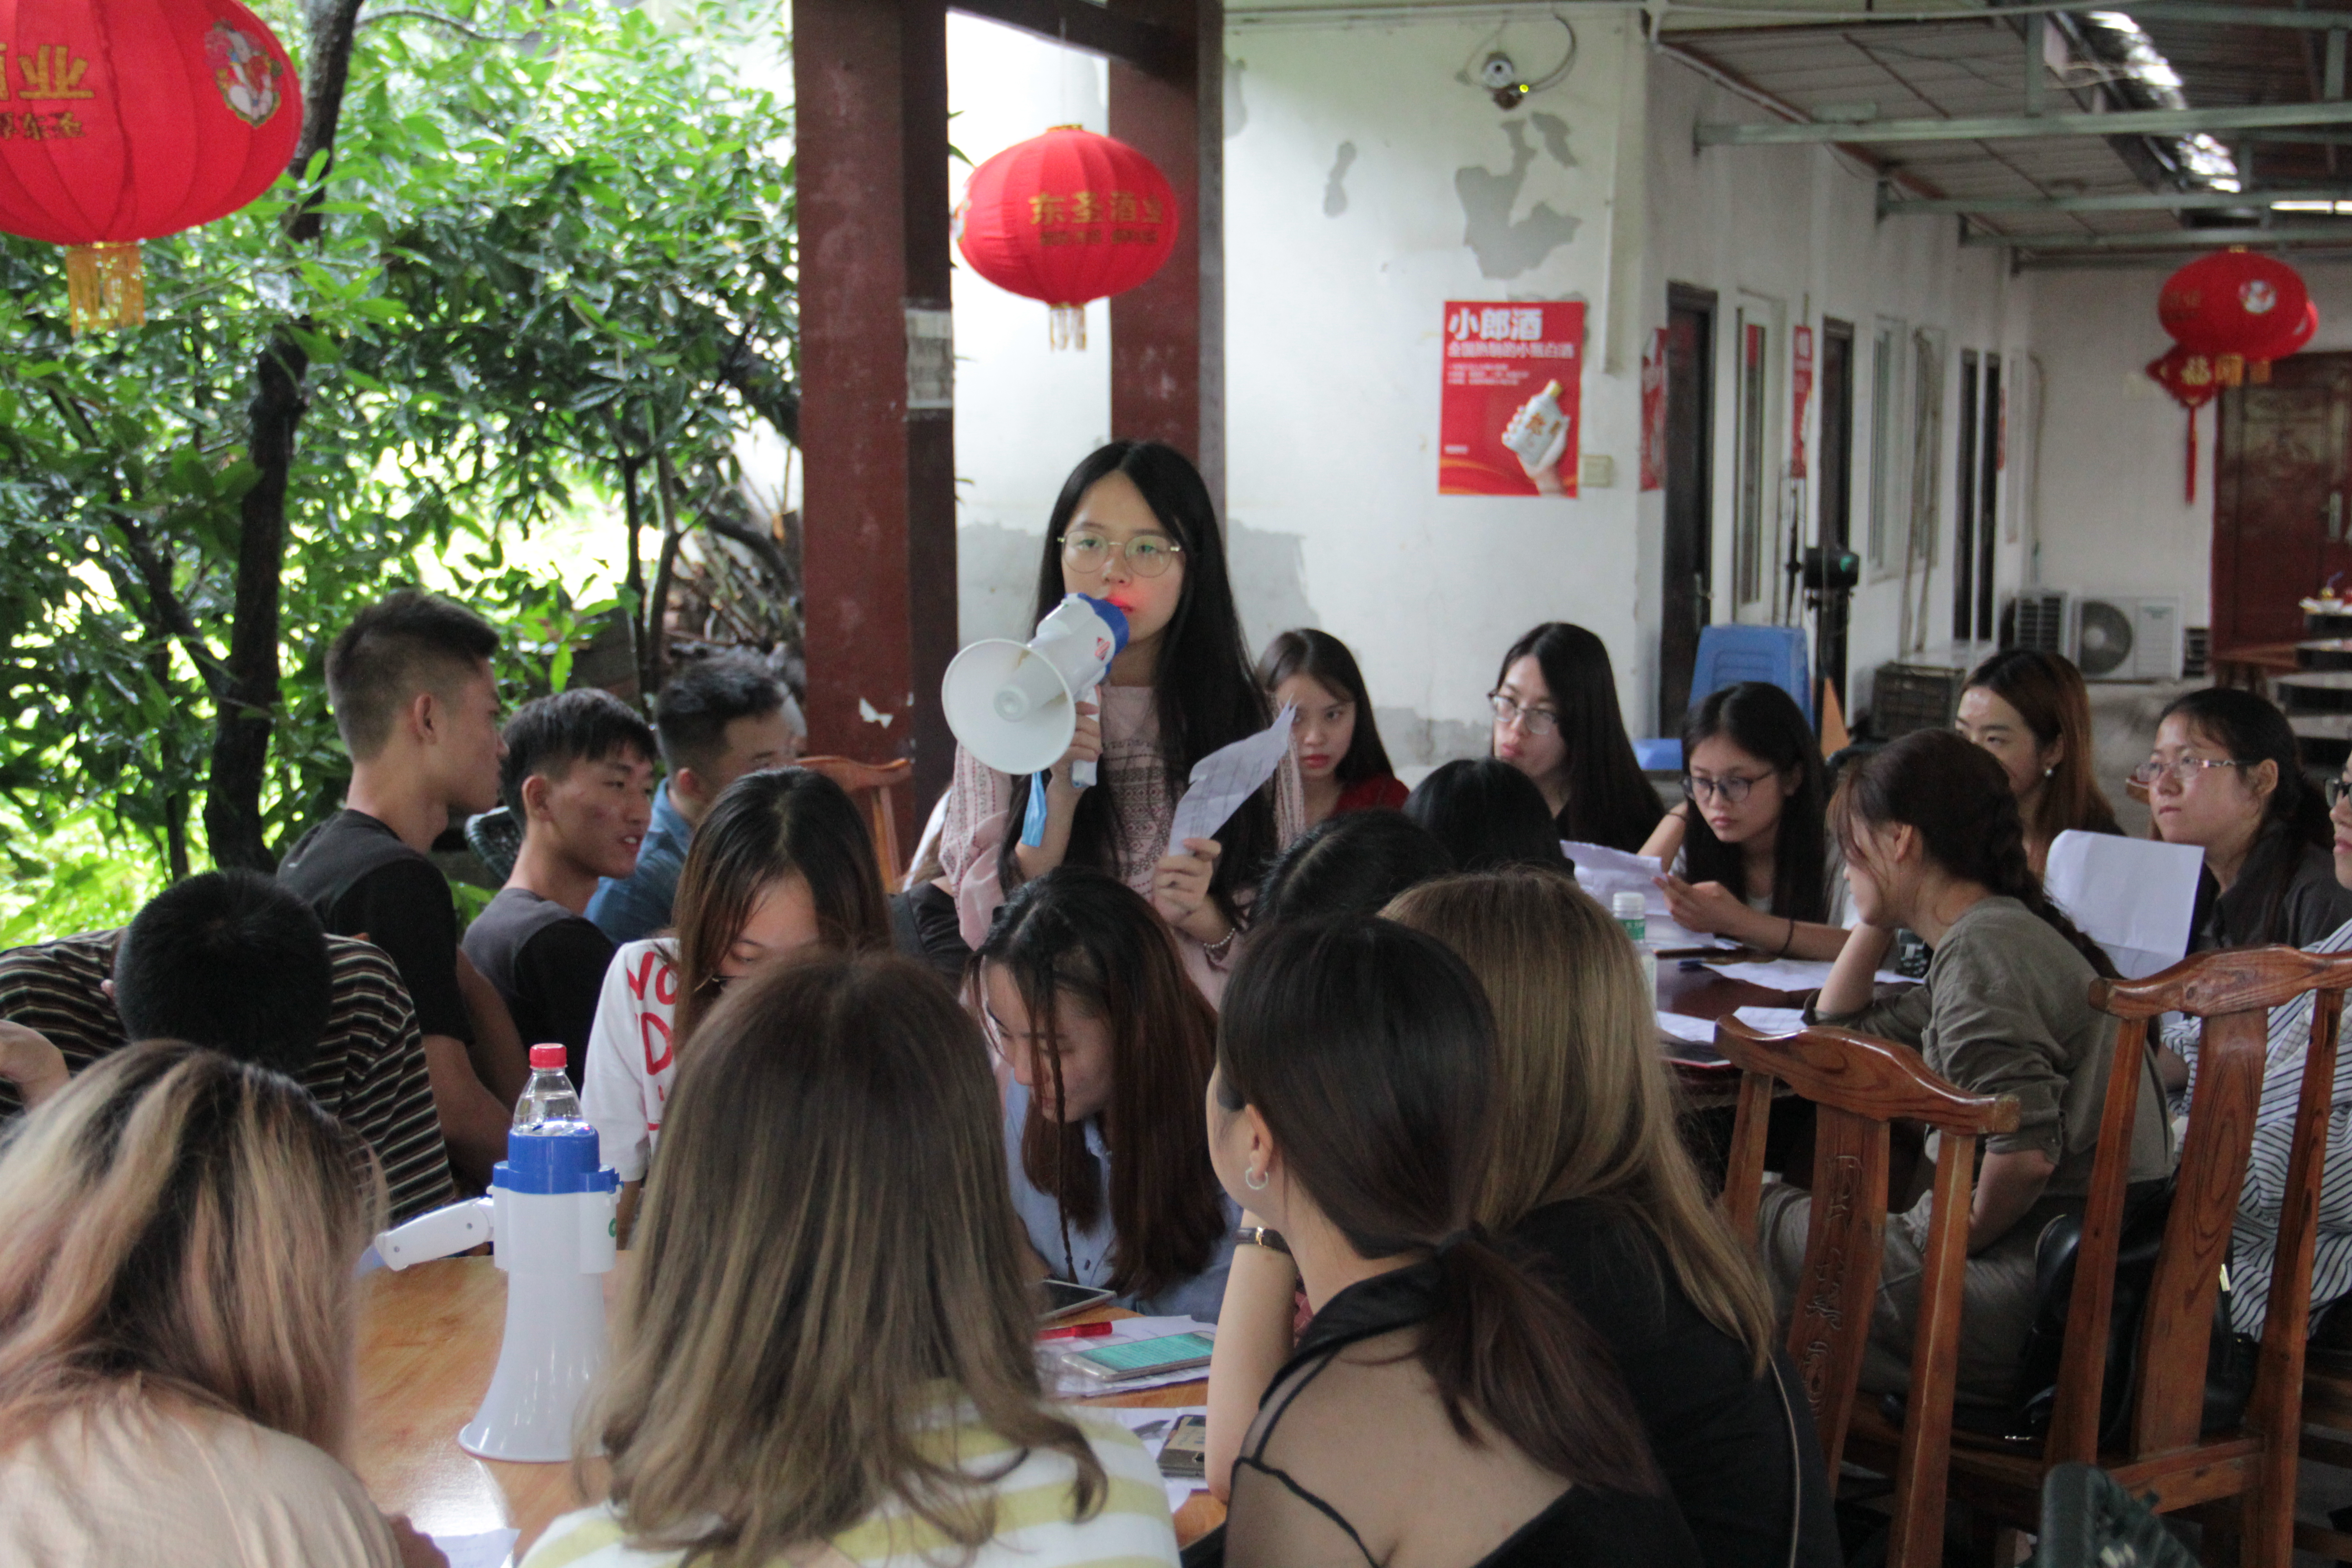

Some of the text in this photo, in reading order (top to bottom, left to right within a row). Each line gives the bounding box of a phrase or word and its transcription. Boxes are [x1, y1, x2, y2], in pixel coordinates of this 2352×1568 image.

[0, 43, 94, 100] 业
[1028, 191, 1163, 225] 东圣酒业
[1448, 307, 1543, 340] 小郎酒
